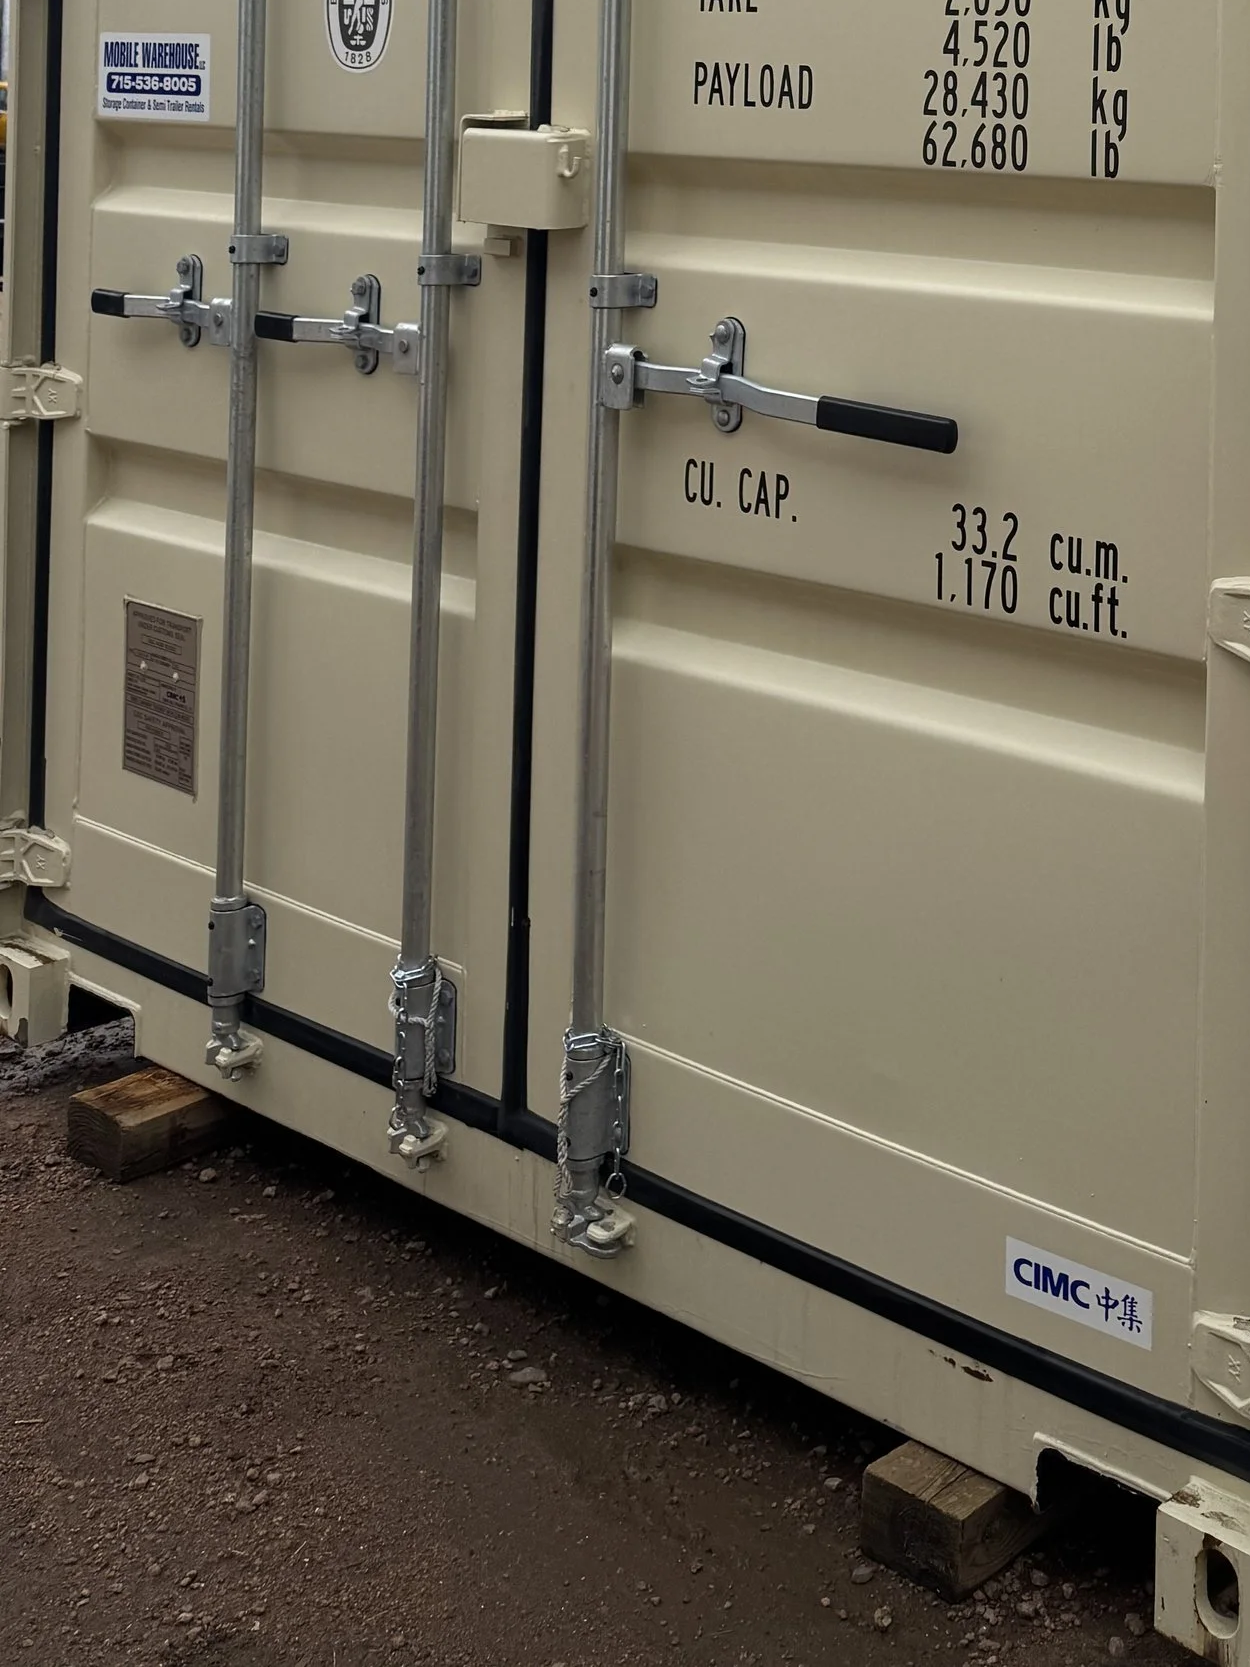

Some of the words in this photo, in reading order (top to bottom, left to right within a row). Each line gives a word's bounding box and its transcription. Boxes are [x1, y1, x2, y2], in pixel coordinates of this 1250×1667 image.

[103, 41, 139, 68] MOBILE
[141, 42, 200, 70] WAREHOUSE
[344, 51, 372, 65] 1828
[942, 20, 1030, 69] 4,520
[1092, 24, 1122, 73] lb
[102, 97, 122, 111] Storage
[122, 98, 146, 110] Container
[152, 100, 166, 111] Semi
[167, 100, 184, 112] Trailer
[184, 101, 205, 113] Rentals
[693, 61, 813, 110] PAYLOAD
[922, 70, 1029, 120] 28,430
[1091, 77, 1128, 143] kg
[921, 121, 1028, 172] 62,680
[1090, 129, 1120, 179] lb
[684, 458, 723, 509] CU.
[738, 467, 798, 523] CAP.
[951, 503, 1019, 562] 33.2
[1050, 533, 1129, 584] cu.m.
[934, 551, 1019, 614] 1,170
[1048, 583, 1128, 639] cu.ft.
[1013, 1257, 1091, 1310] CIMC
[1095, 1286, 1143, 1334] 中集
